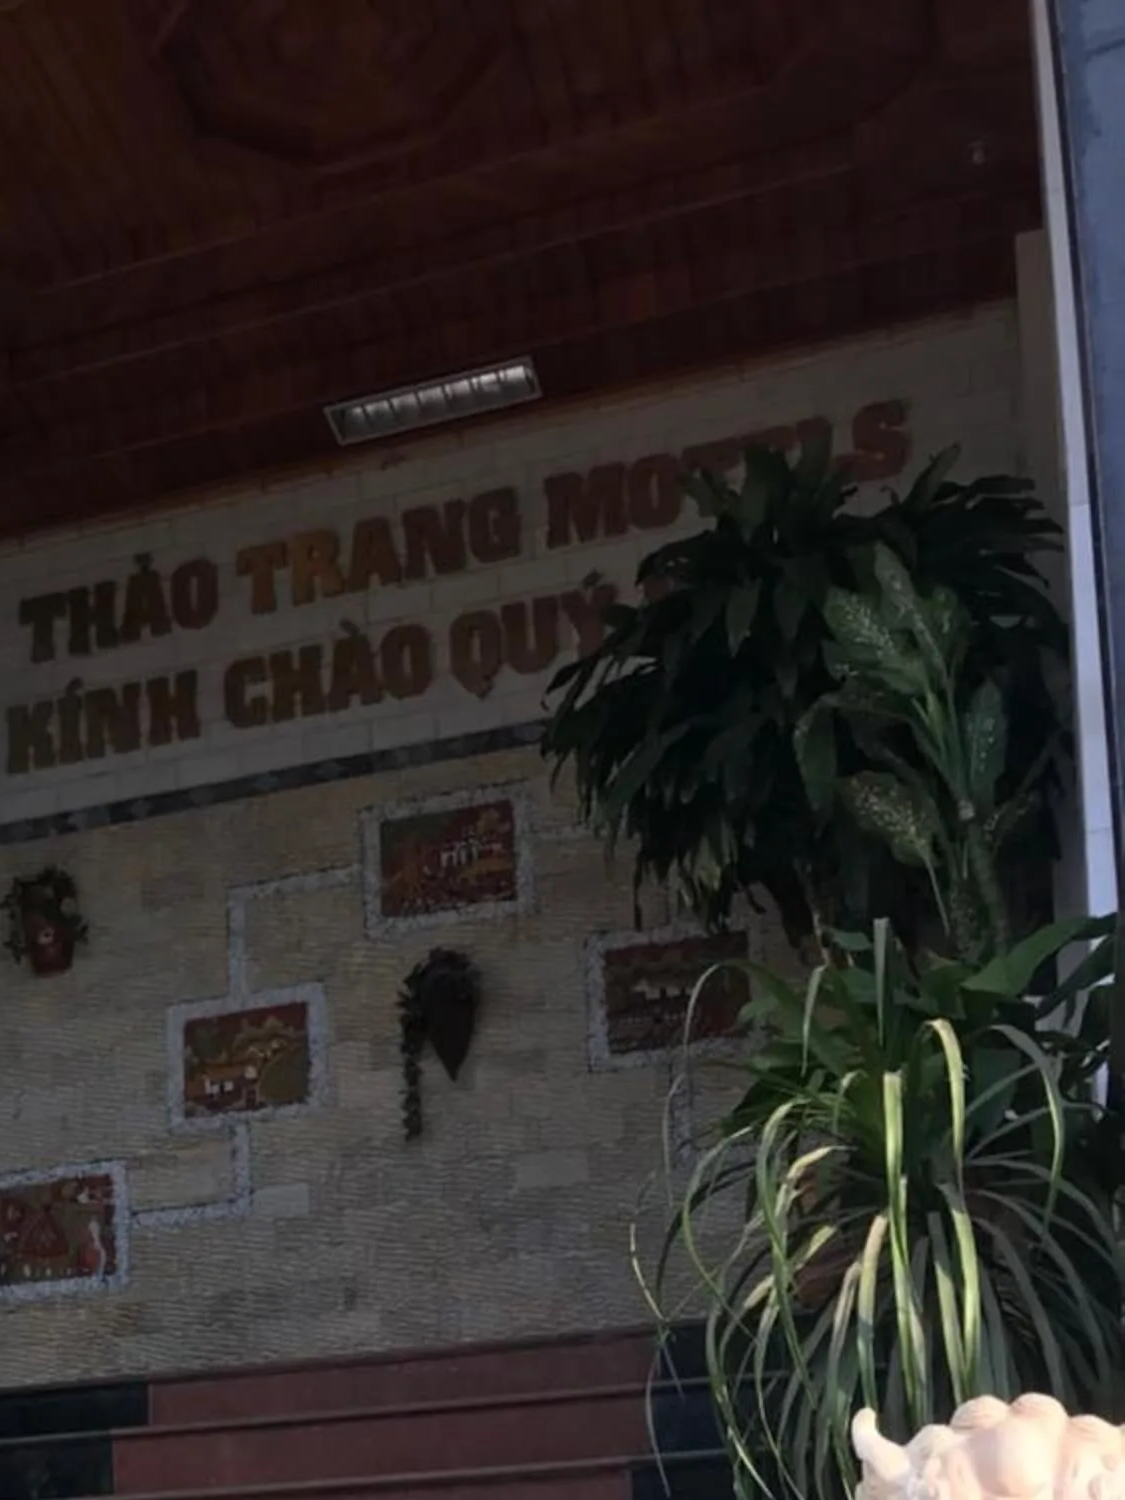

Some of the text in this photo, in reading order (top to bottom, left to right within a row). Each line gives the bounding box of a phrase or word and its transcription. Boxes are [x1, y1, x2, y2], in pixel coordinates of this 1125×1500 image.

[18, 552, 219, 664] THẢO
[236, 486, 522, 615] TRANG
[6, 669, 201, 775] KÍNH
[223, 617, 433, 730] CHÀO
